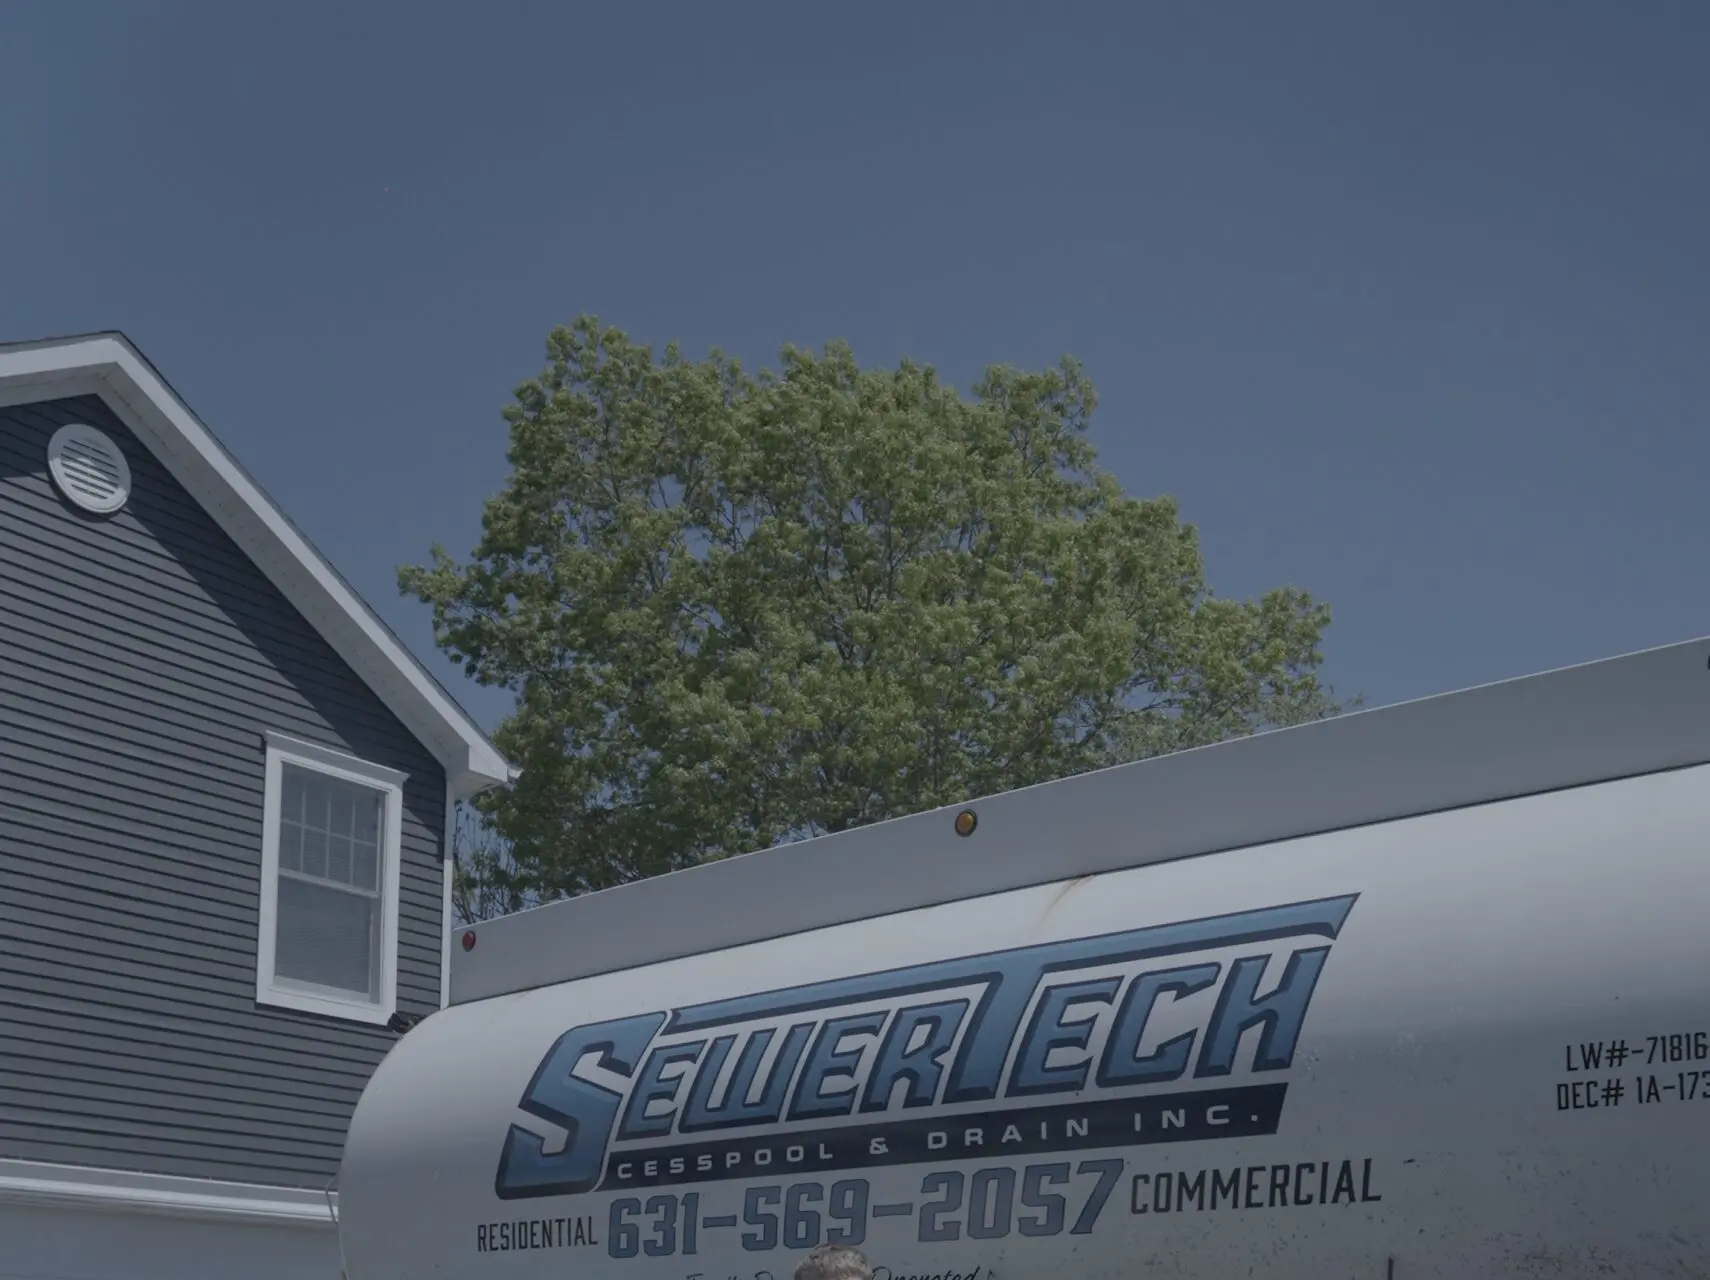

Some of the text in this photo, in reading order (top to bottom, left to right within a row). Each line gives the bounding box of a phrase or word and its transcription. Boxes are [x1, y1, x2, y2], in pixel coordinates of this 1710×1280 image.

[1556, 1078, 1625, 1111] DEC#
[617, 1104, 1259, 1180] CESSPOOL & DRAIN INC.
[477, 1157, 1382, 1259] RESIDENTIAL 631-569-2057 COMMERCIAL
